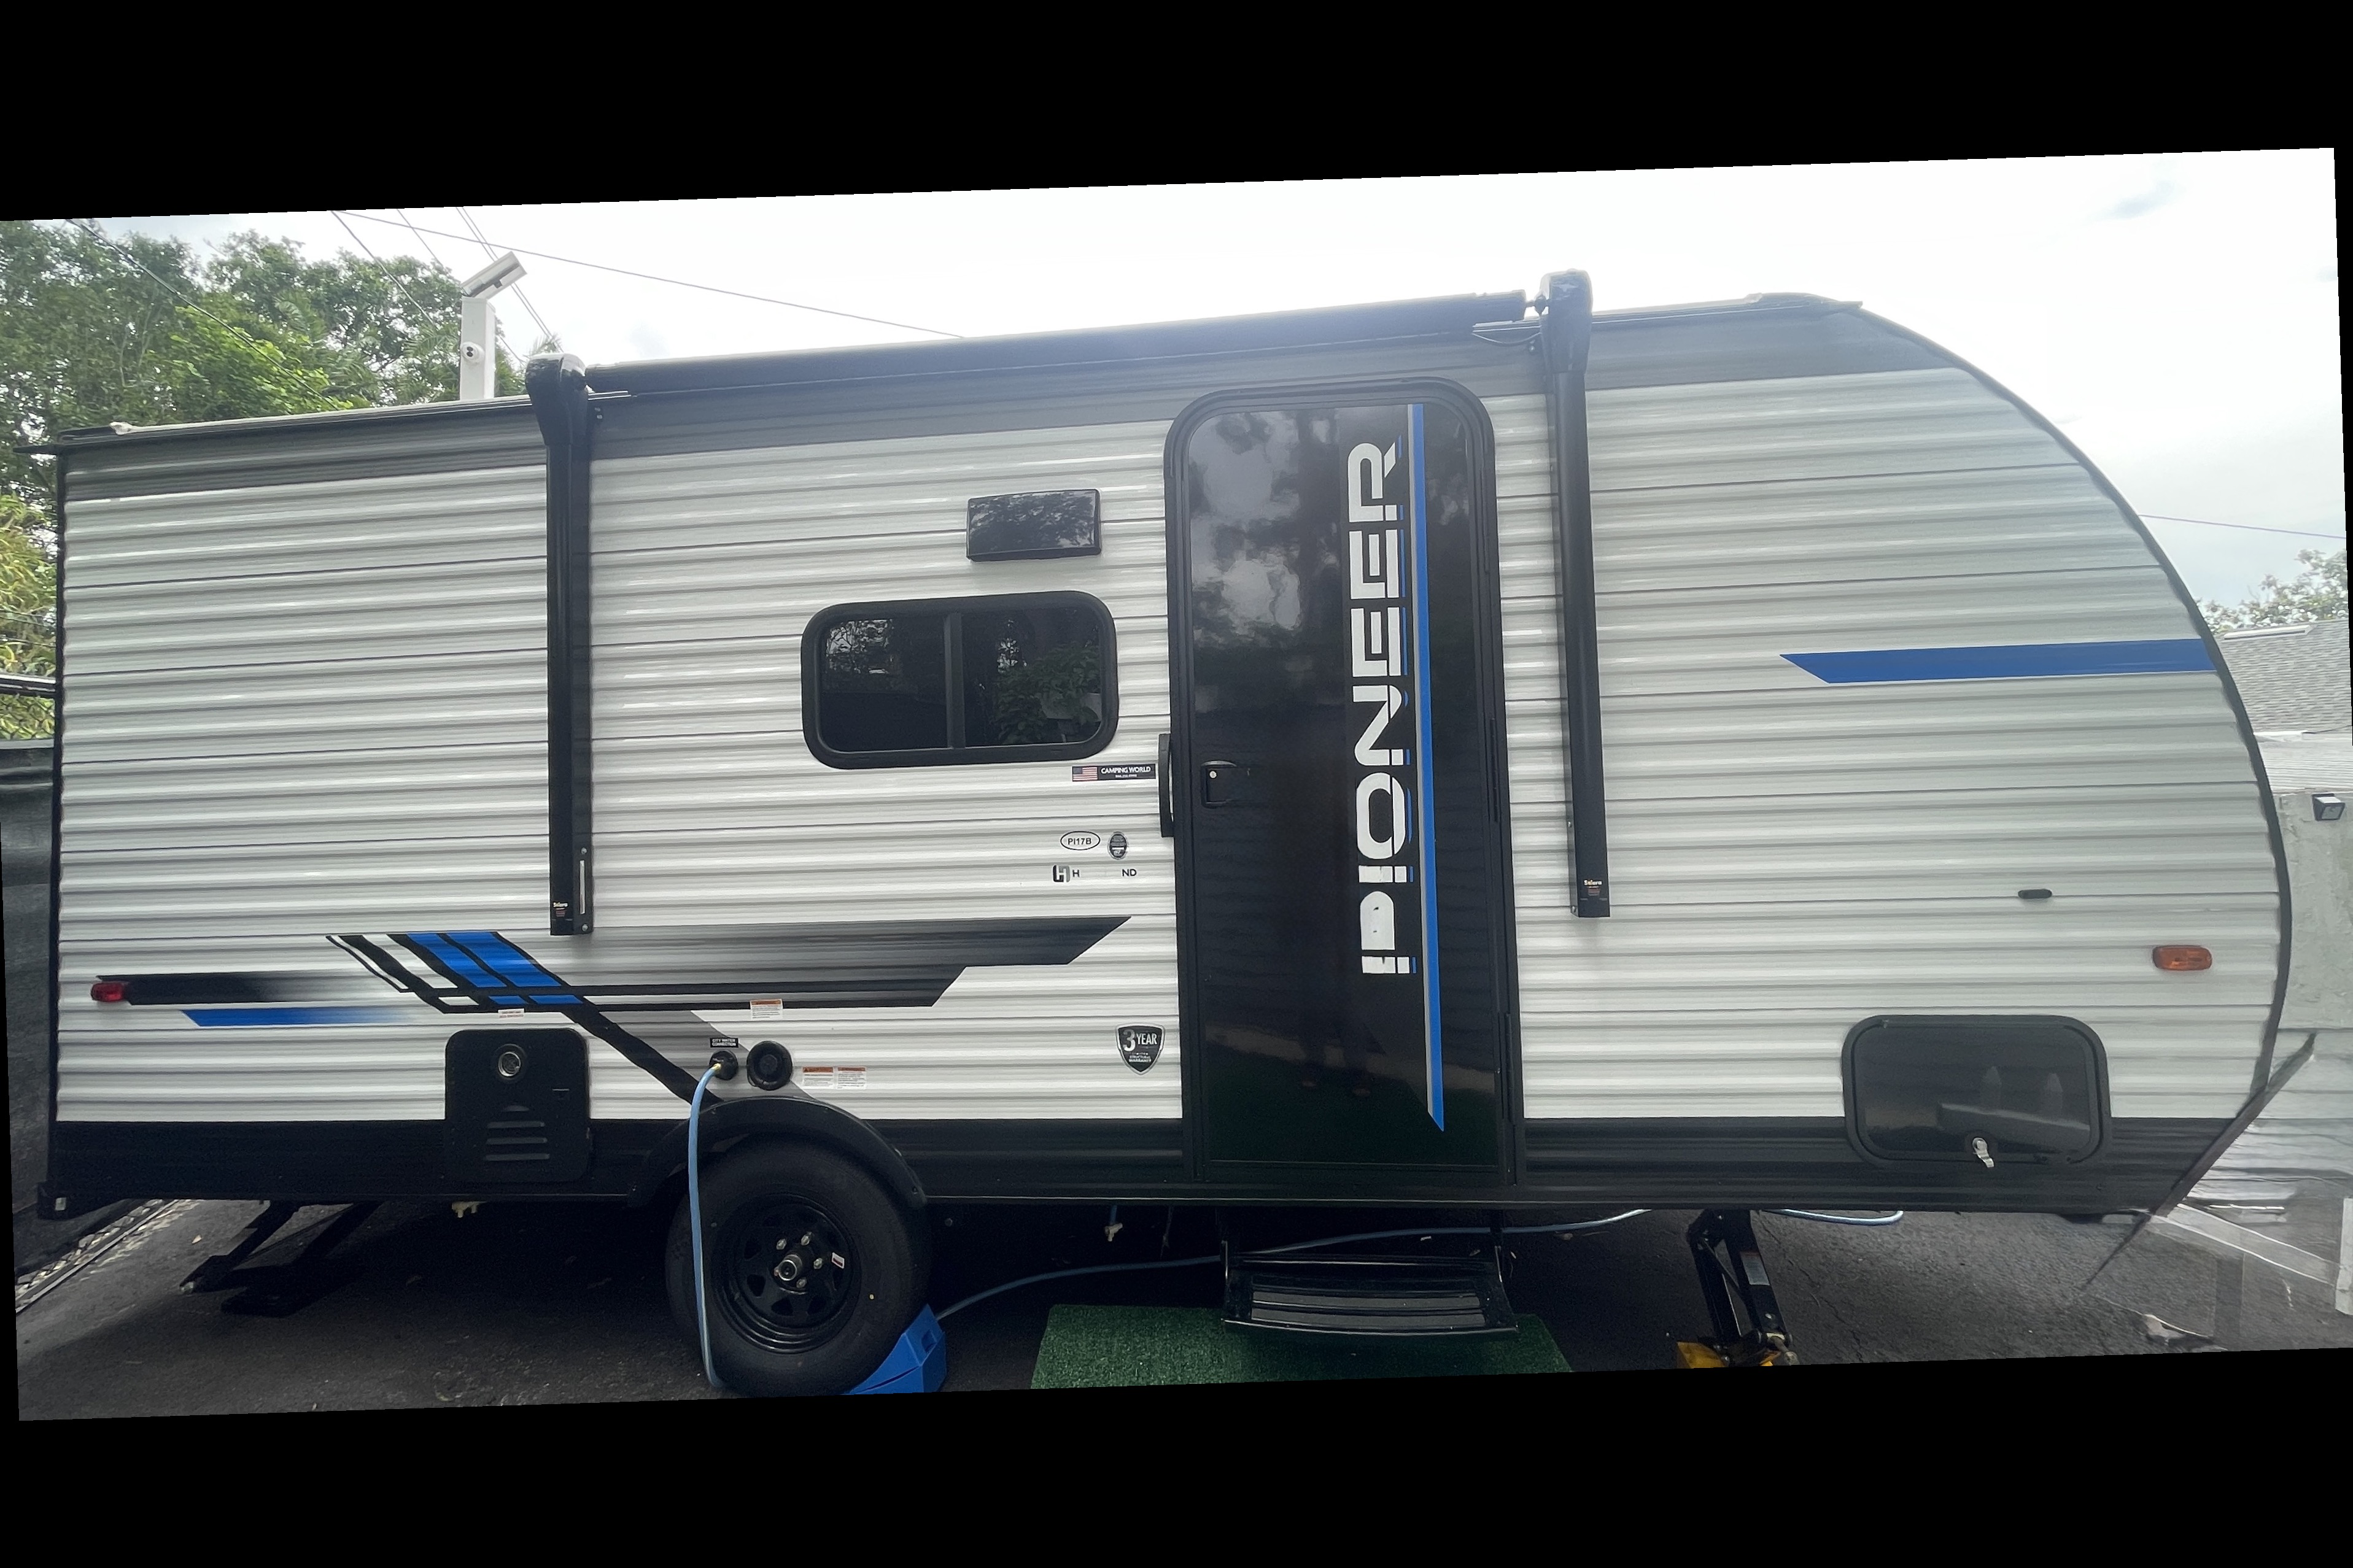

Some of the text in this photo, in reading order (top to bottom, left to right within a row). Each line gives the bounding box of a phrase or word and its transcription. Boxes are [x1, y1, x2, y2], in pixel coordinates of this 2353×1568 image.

[1347, 438, 1414, 975] PIONEER
[1122, 868, 1138, 877] ND
[1123, 1029, 1158, 1052] 3 YEAR
